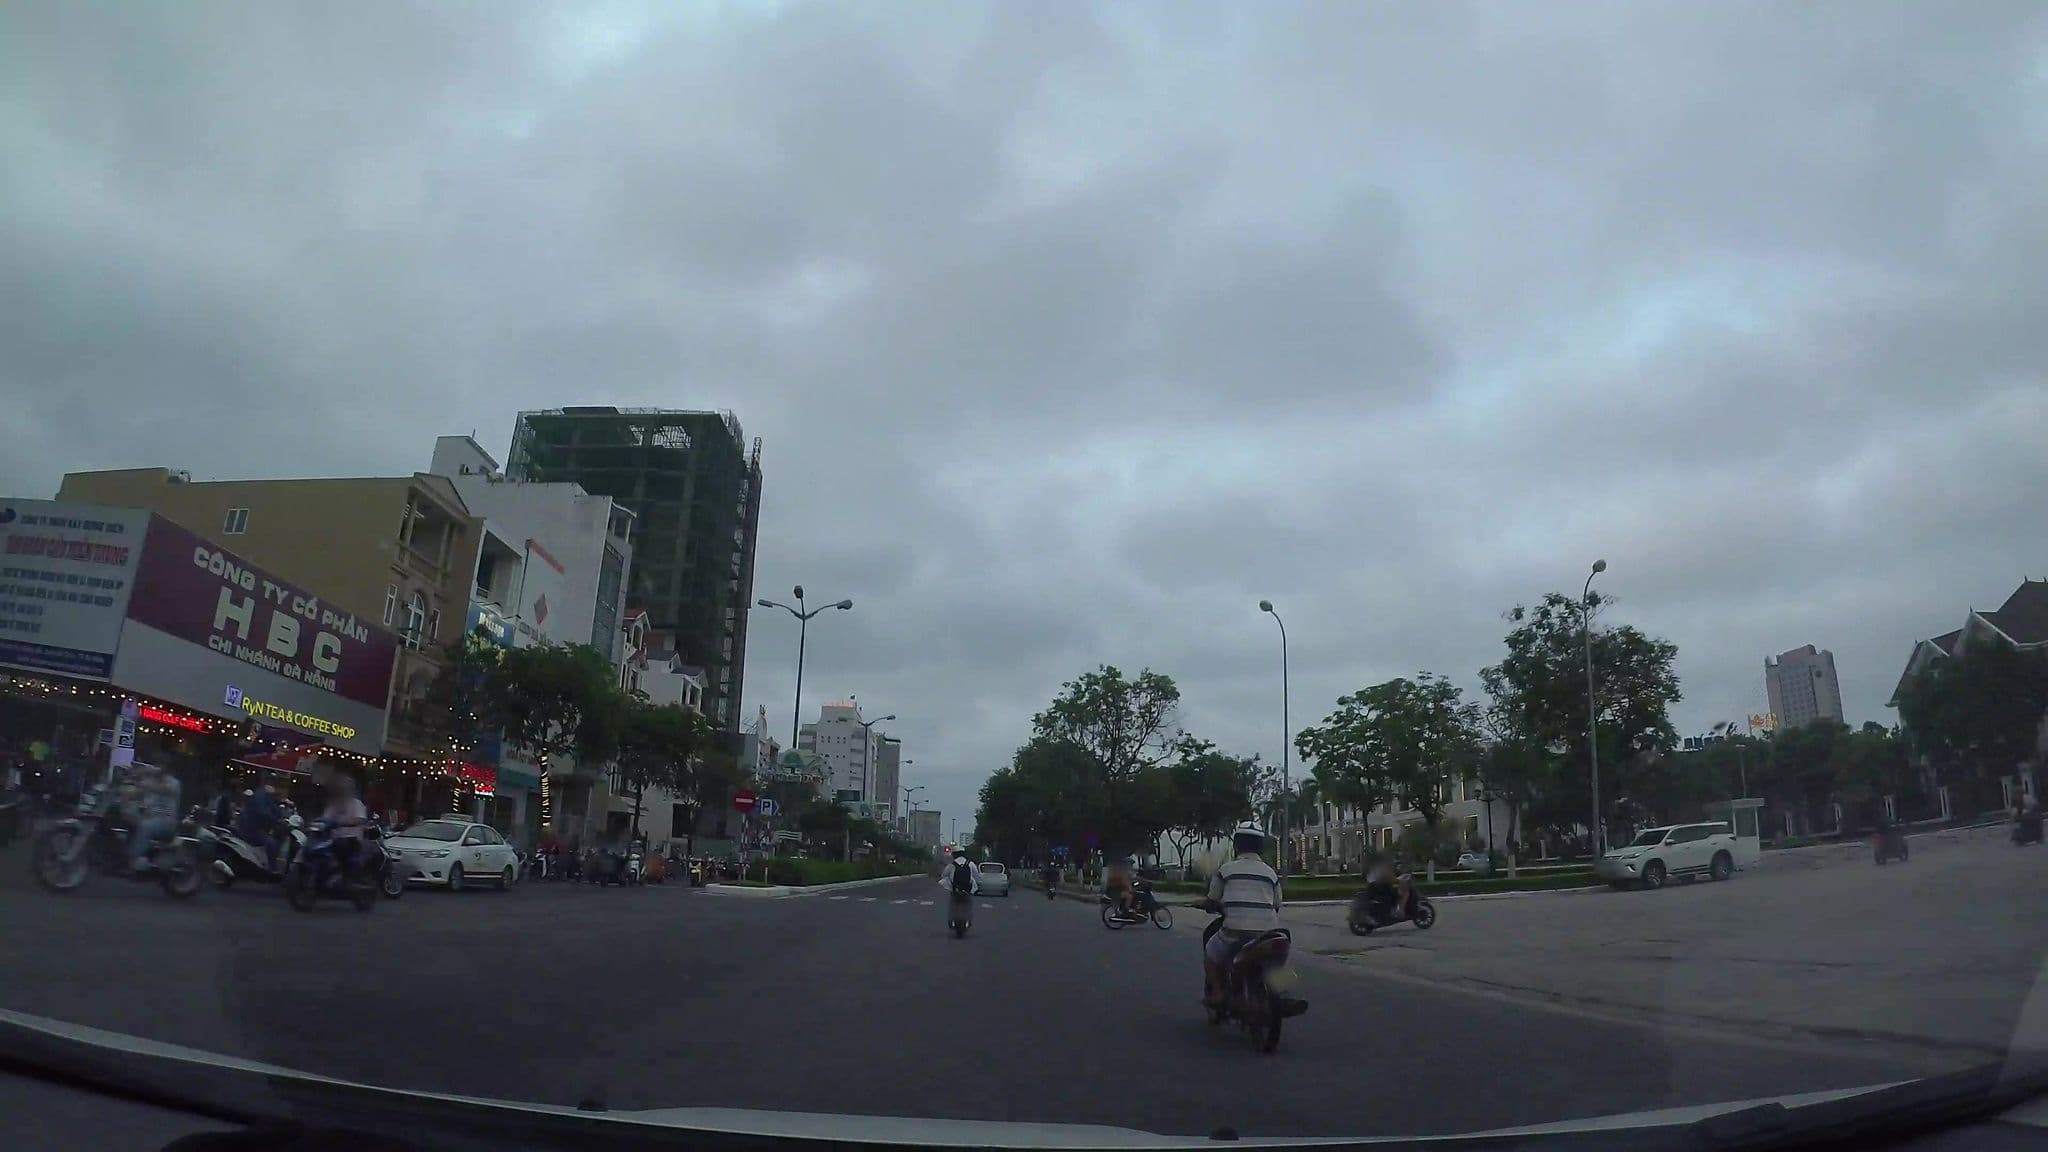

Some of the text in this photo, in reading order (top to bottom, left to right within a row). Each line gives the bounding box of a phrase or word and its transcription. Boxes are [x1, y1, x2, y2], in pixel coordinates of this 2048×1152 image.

[194, 546, 256, 591] CÔNG
[263, 579, 289, 605] TY
[208, 634, 232, 654] CHI
[235, 644, 281, 673] NHÁNH
[242, 697, 356, 740] RyN TEA & COFFEE SHOP
